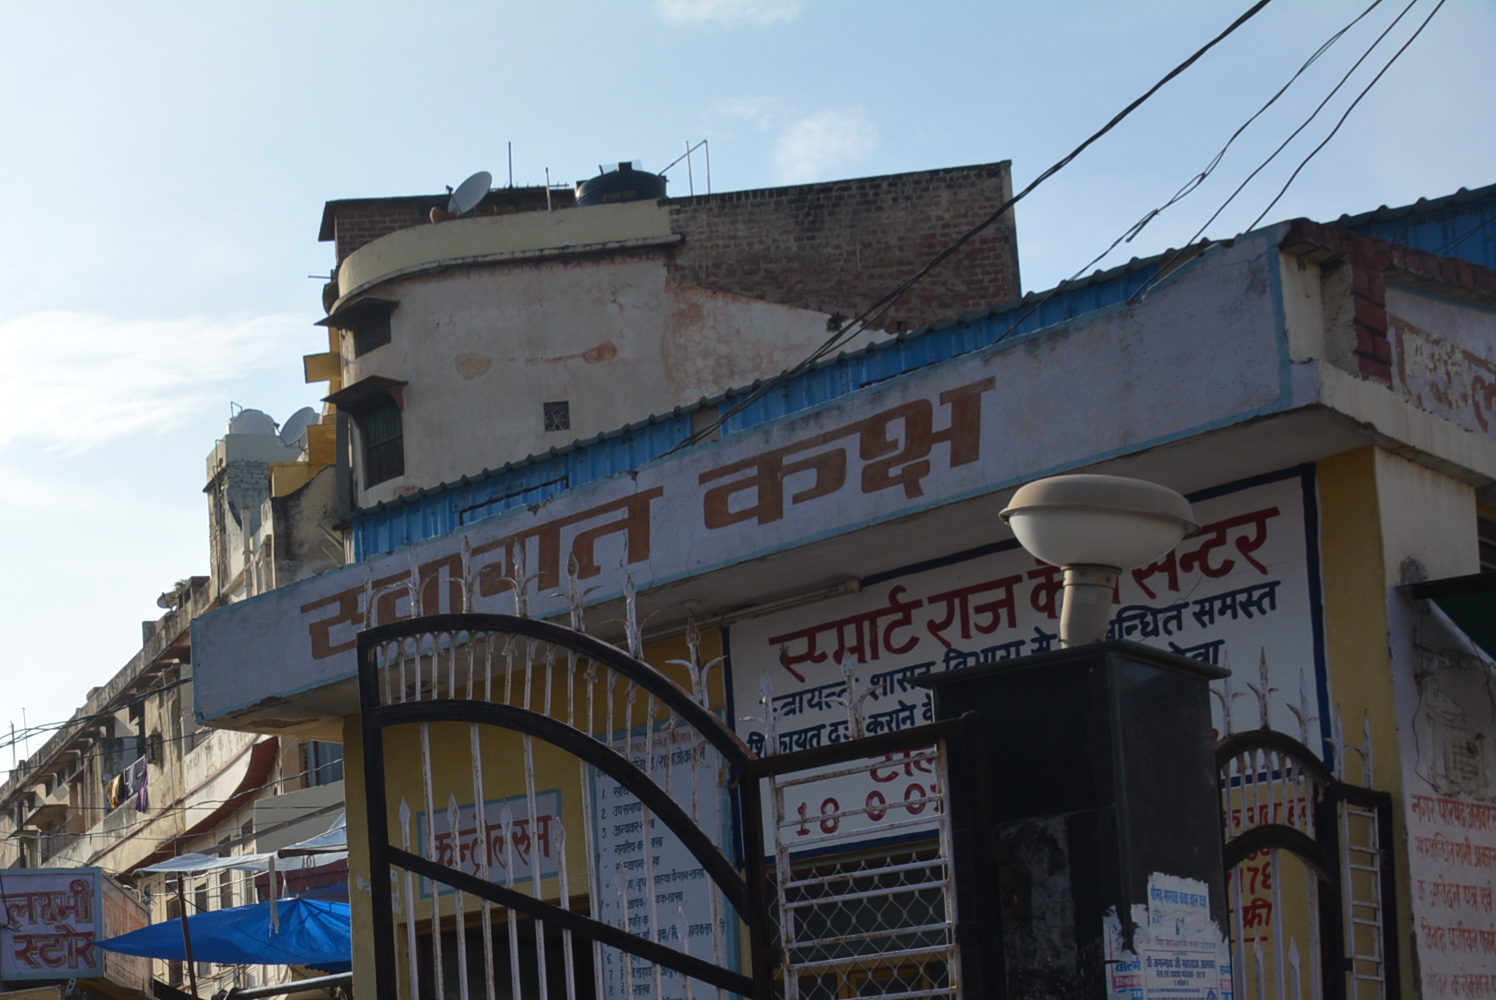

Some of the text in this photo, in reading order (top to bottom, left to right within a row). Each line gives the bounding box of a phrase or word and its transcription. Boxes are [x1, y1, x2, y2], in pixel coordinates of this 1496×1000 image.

[698, 376, 995, 530] कक्ष
[1193, 580, 1281, 629] समस्त
[13, 923, 96, 969] स्टोर
